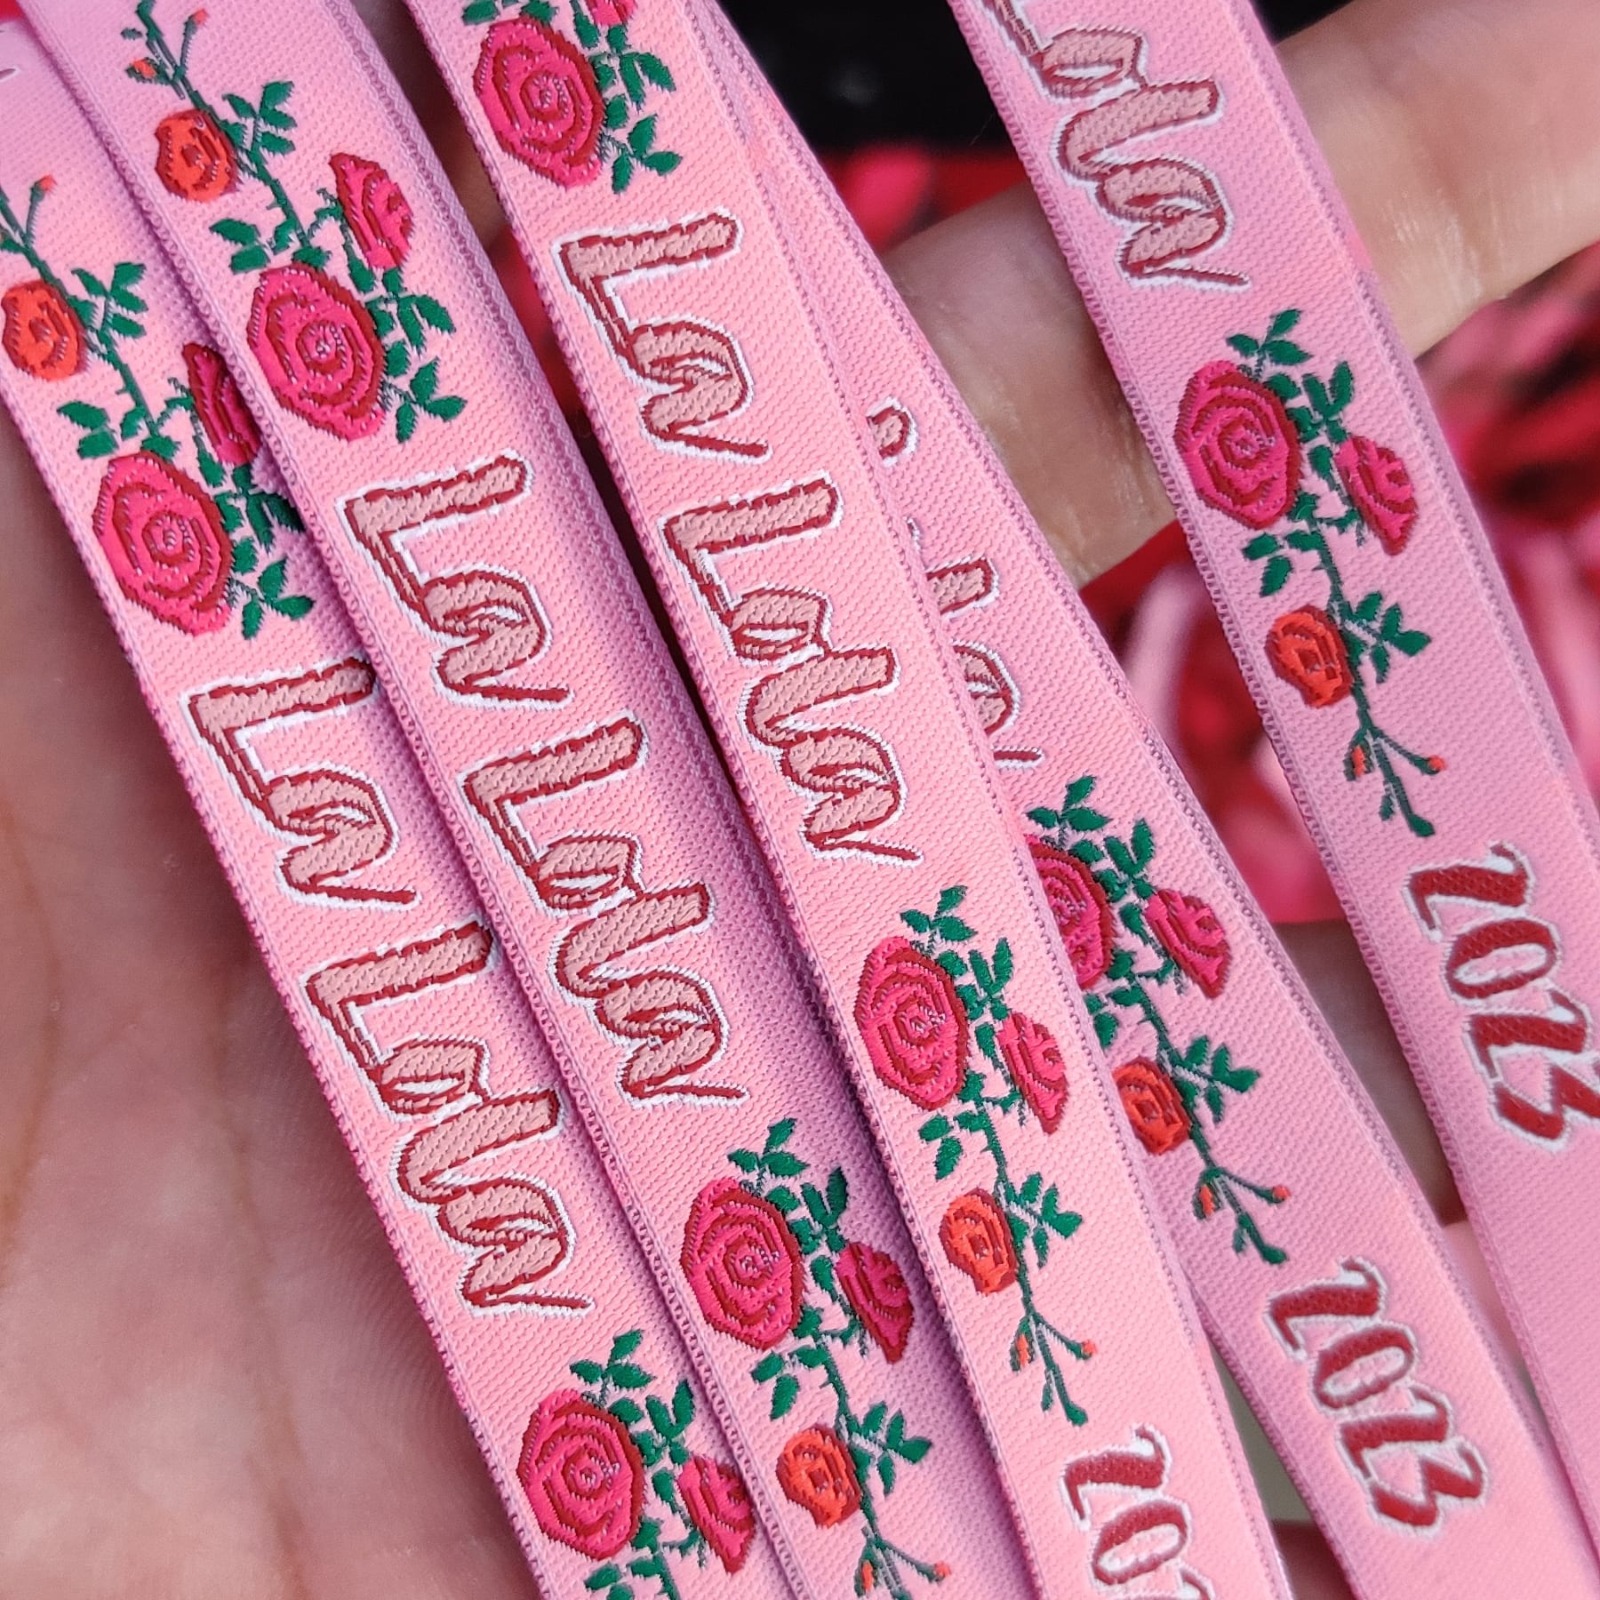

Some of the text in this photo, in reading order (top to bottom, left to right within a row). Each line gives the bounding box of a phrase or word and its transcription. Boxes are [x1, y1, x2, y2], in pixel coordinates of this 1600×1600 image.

[978, 0, 1248, 289] ola
[555, 210, 922, 866] La Lola
[186, 657, 591, 1312] La Lola
[340, 453, 746, 1104] La Lola
[1408, 842, 1600, 1148] 2023
[1266, 1258, 1487, 1537] 2023
